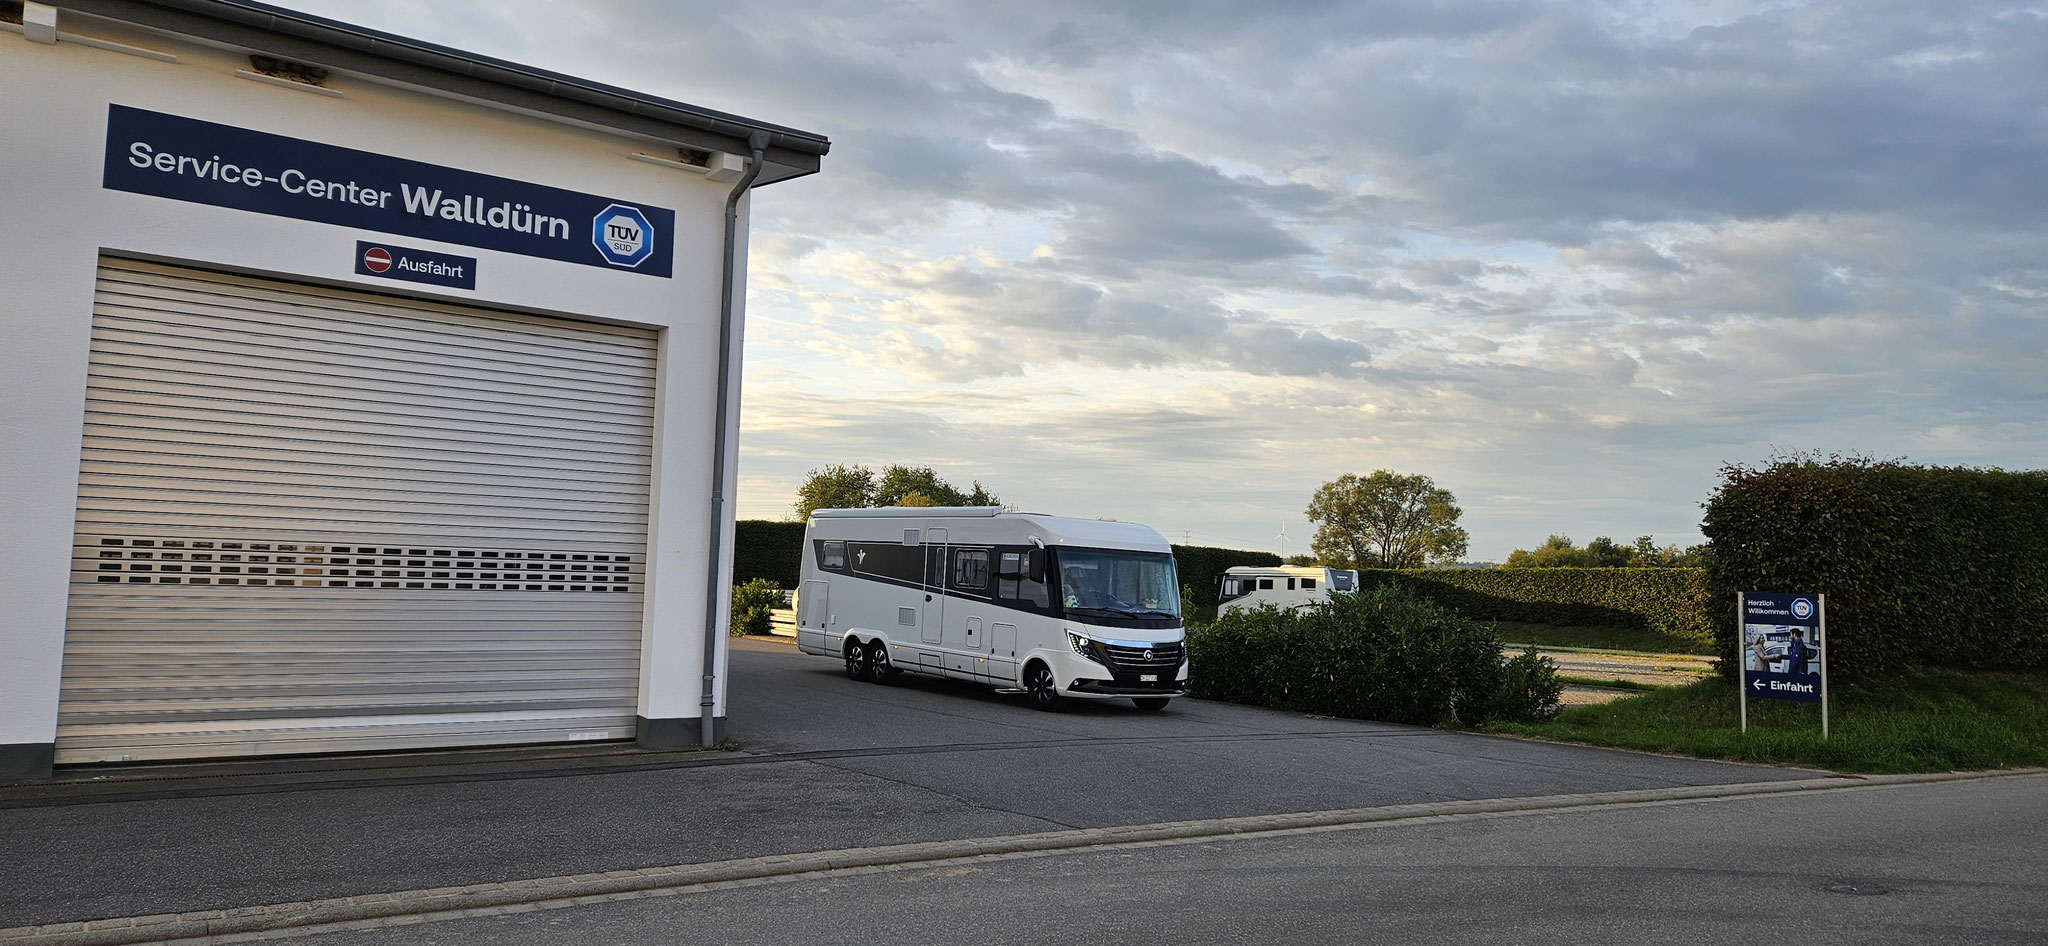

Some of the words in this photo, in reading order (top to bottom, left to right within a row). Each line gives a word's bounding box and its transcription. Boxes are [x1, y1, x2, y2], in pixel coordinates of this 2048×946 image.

[127, 142, 392, 209] Service-Center
[400, 183, 570, 239] Walldürn
[608, 224, 639, 241] TÜV
[614, 243, 632, 252] SÜD
[397, 256, 463, 278] Ausfahrt
[1770, 680, 1813, 693] Einfahrt
